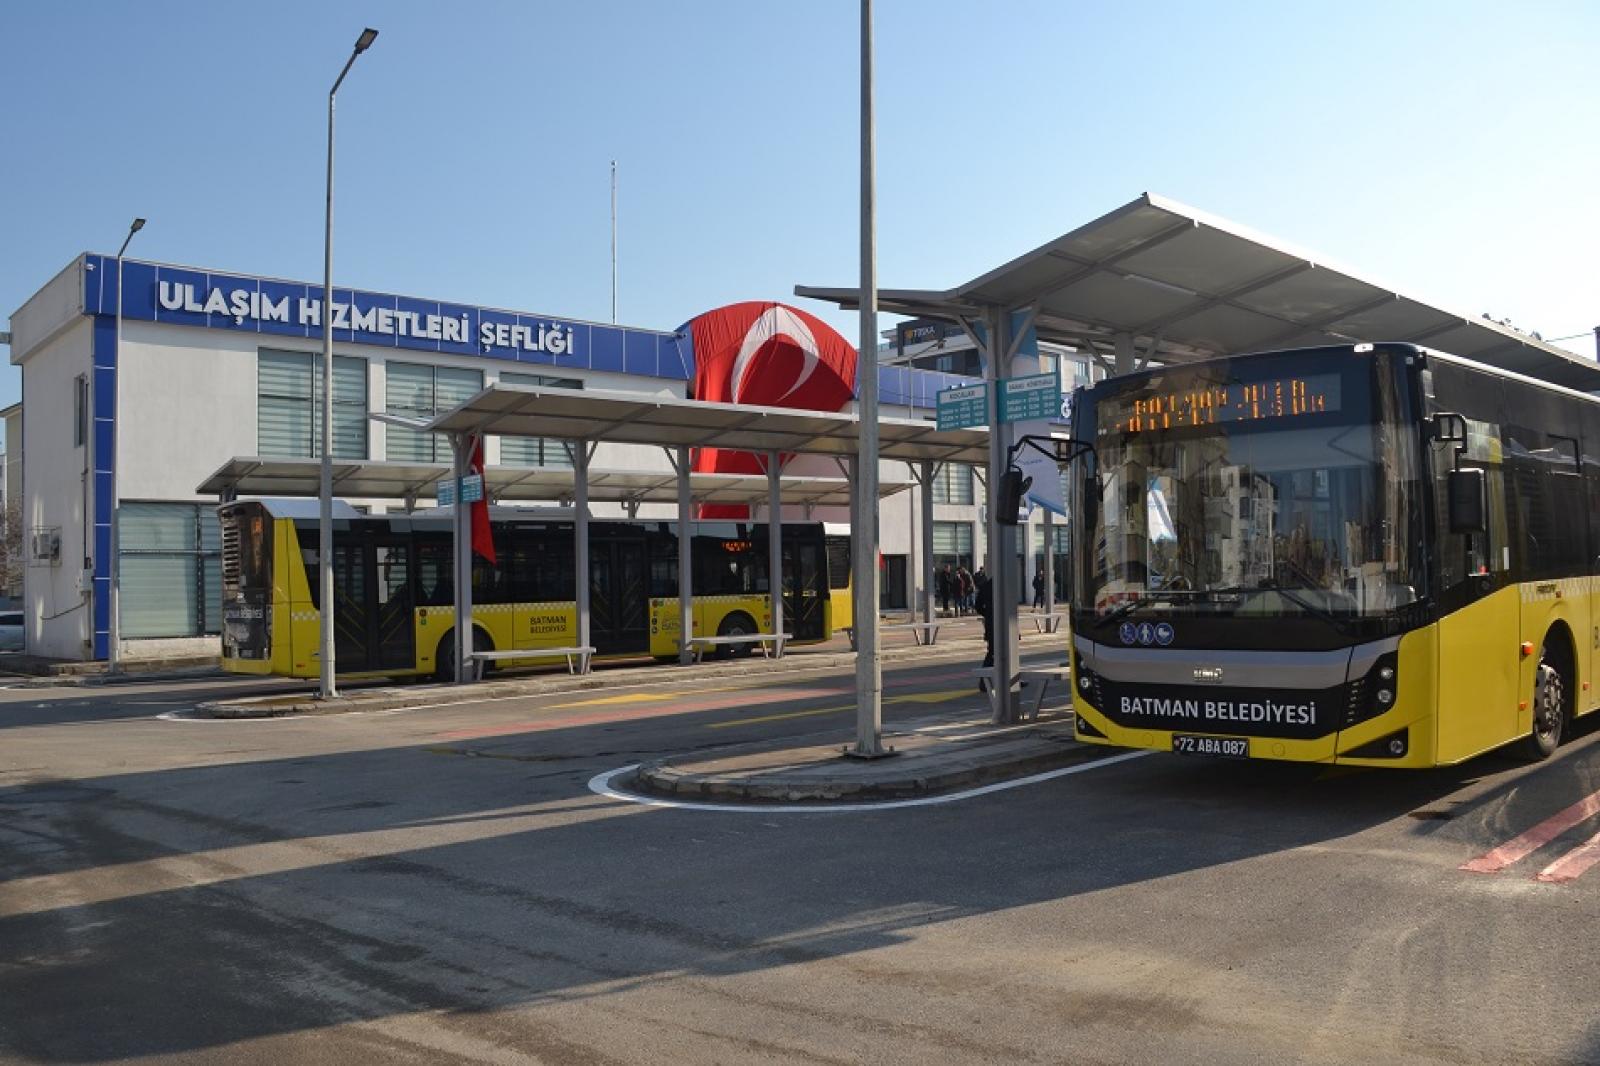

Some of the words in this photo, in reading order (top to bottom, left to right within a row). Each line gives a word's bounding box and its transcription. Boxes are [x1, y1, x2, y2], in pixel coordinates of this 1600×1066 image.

[158, 280, 289, 326] ULAŞIM
[479, 321, 574, 356] ŞEFLİĞİ
[529, 615, 567, 625] BATMAN
[1121, 696, 1199, 719] BATMAN
[1205, 699, 1317, 725] BELEDİYESİ
[1180, 737, 1195, 752] 72
[1197, 738, 1221, 754] ABA
[1222, 740, 1248, 756] 087
